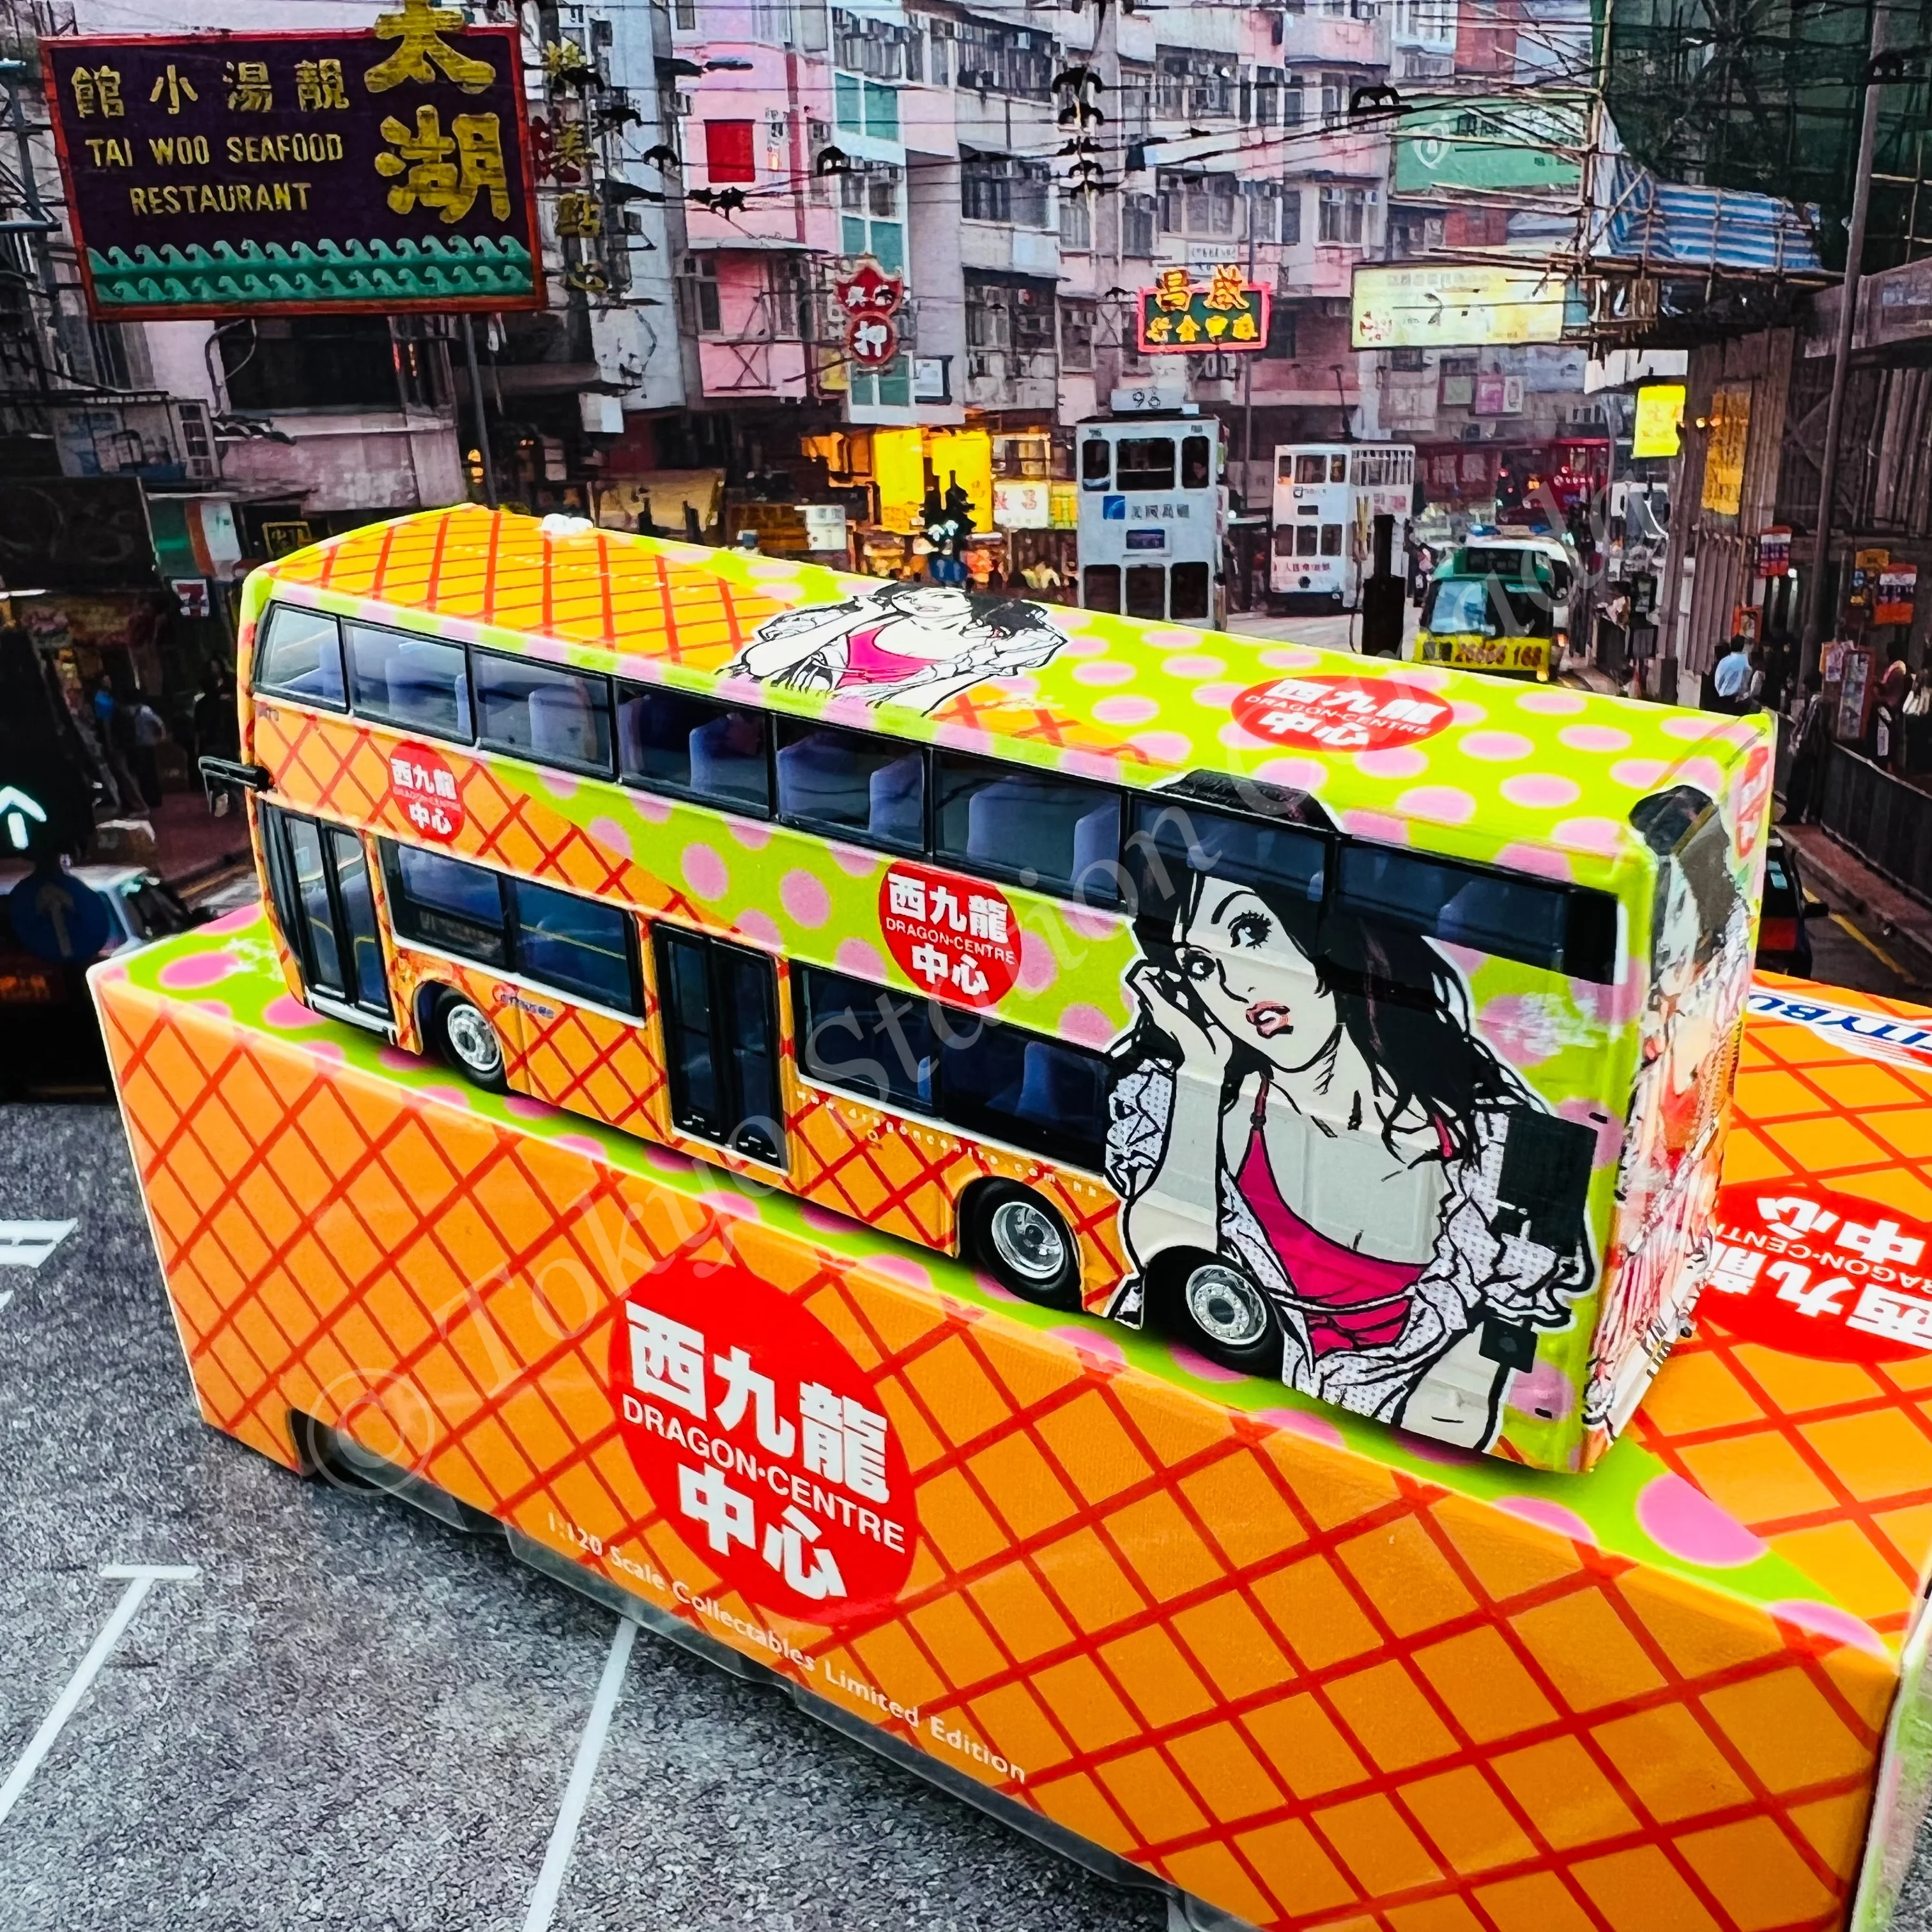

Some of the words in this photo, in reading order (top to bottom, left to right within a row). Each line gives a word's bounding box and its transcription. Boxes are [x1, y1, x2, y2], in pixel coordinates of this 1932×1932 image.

[364, 0, 510, 224] 太湖
[85, 138, 133, 167] TAI
[149, 135, 210, 166] WOO
[227, 133, 344, 164] SEAFOOD
[129, 182, 312, 217] RESTAURANT
[1258, 710, 1370, 746] 中心
[408, 802, 453, 835] 中心
[887, 872, 1009, 944] 西九龍
[911, 942, 990, 996] 中心
[1749, 994, 1932, 1050] ITYBU
[1757, 1196, 1926, 1266] 中心
[625, 1300, 890, 1504] 西九龍
[677, 1462, 848, 1600] 中心
[609, 1545, 666, 1591] Scale
[672, 1580, 816, 1672] Collectables
[825, 1660, 919, 1728] Limited
[930, 1715, 1025, 1784] Edition
